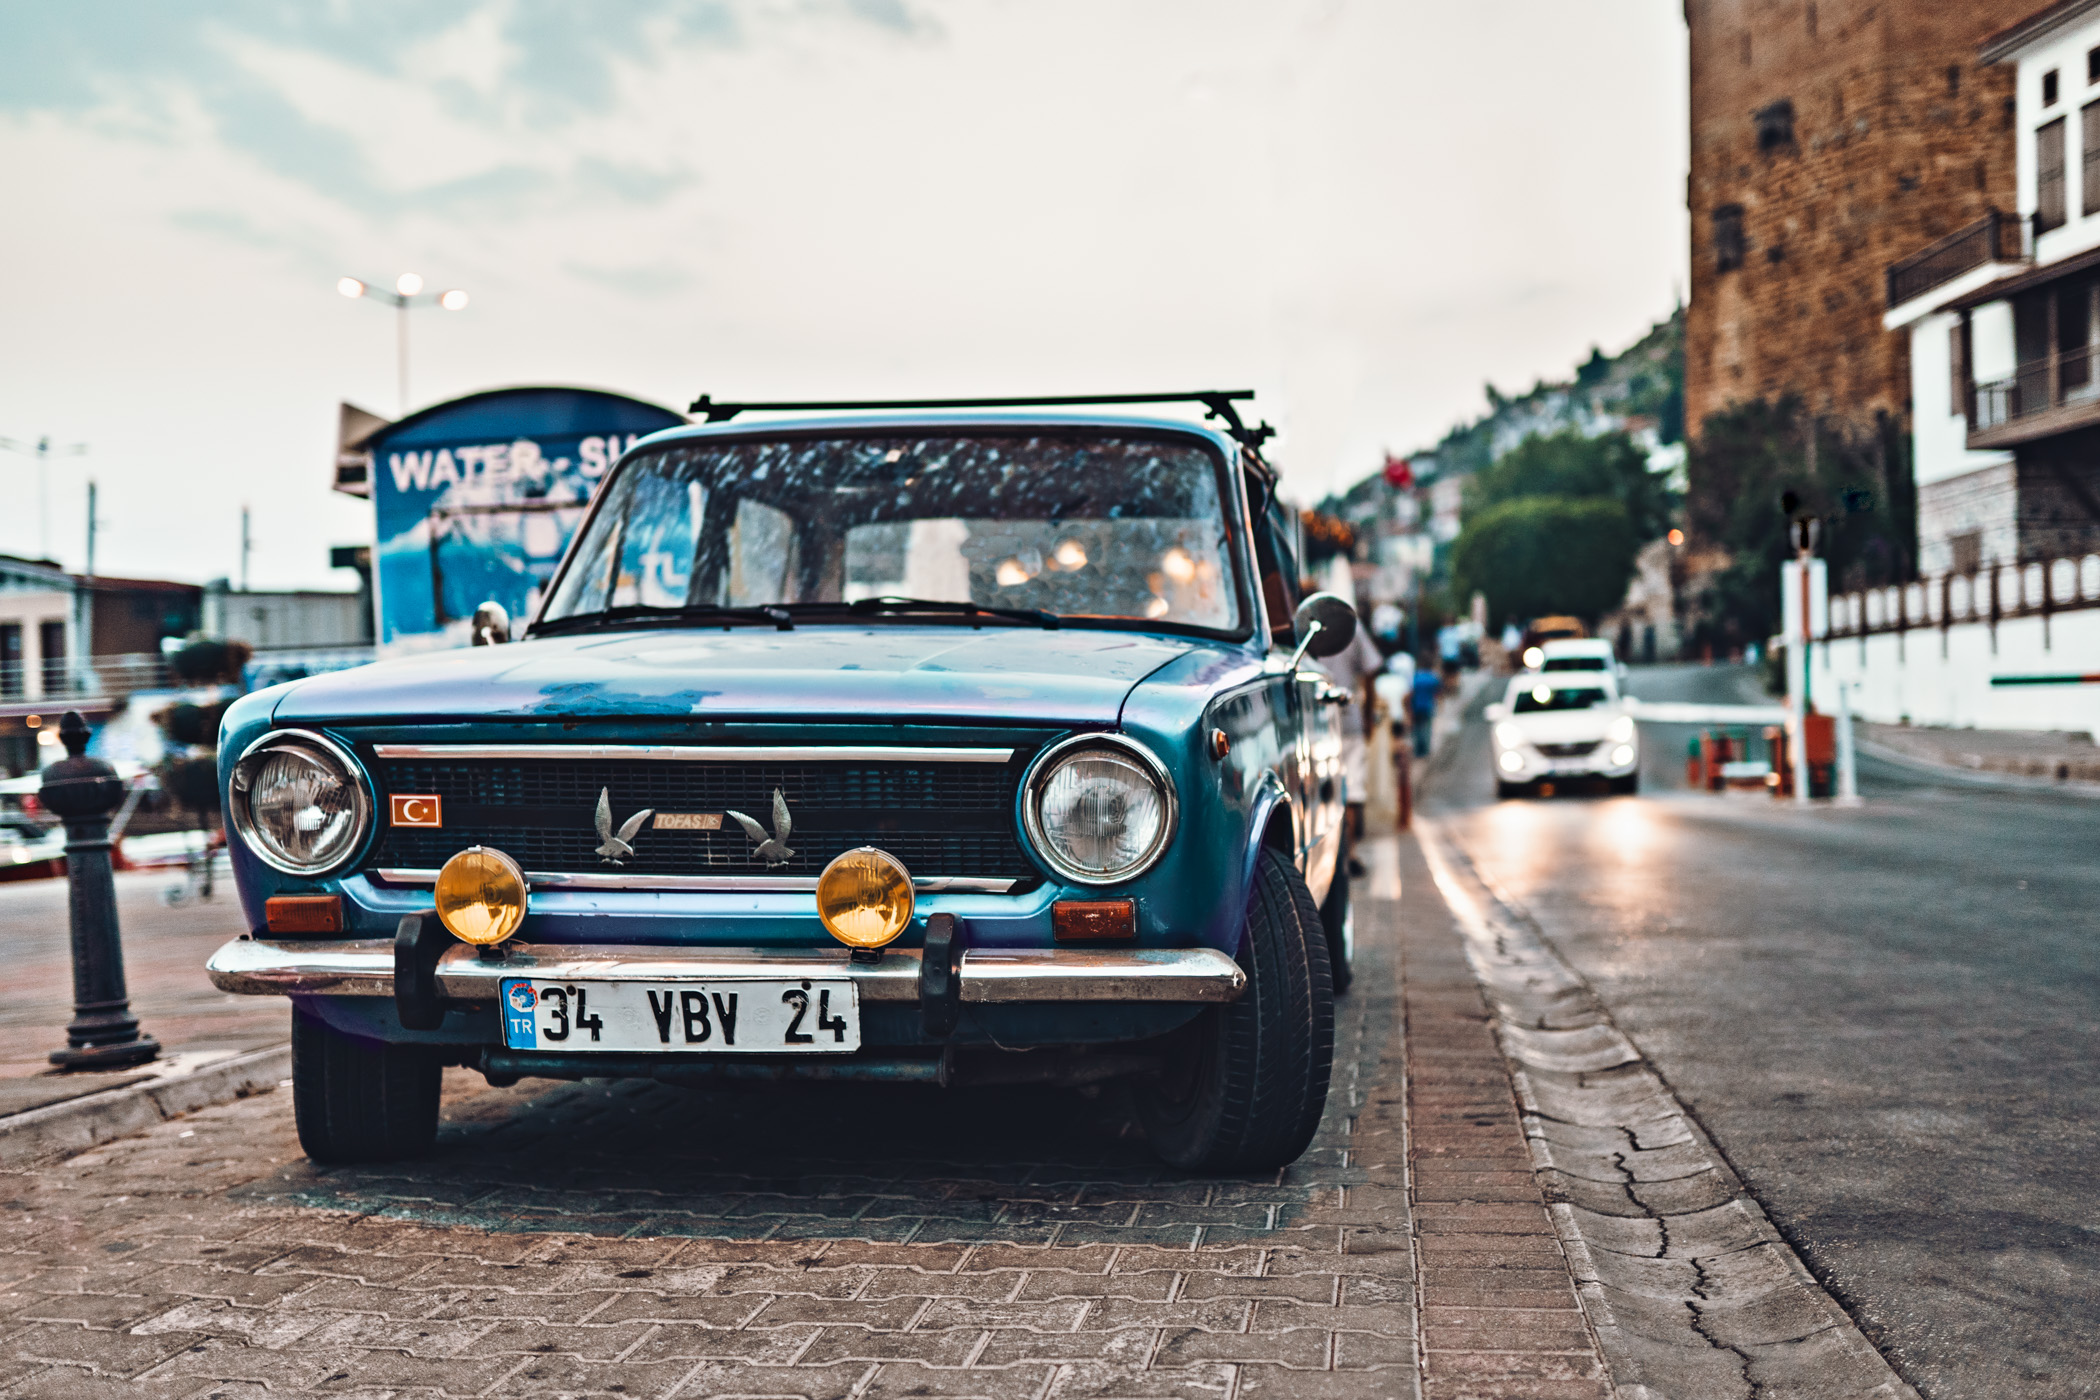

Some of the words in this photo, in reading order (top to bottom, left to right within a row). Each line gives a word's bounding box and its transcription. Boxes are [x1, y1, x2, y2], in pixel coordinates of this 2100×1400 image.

[510, 1018, 532, 1034] TR
[540, 987, 603, 1042] 34
[646, 989, 738, 1045] VBV
[781, 989, 847, 1043] 24
